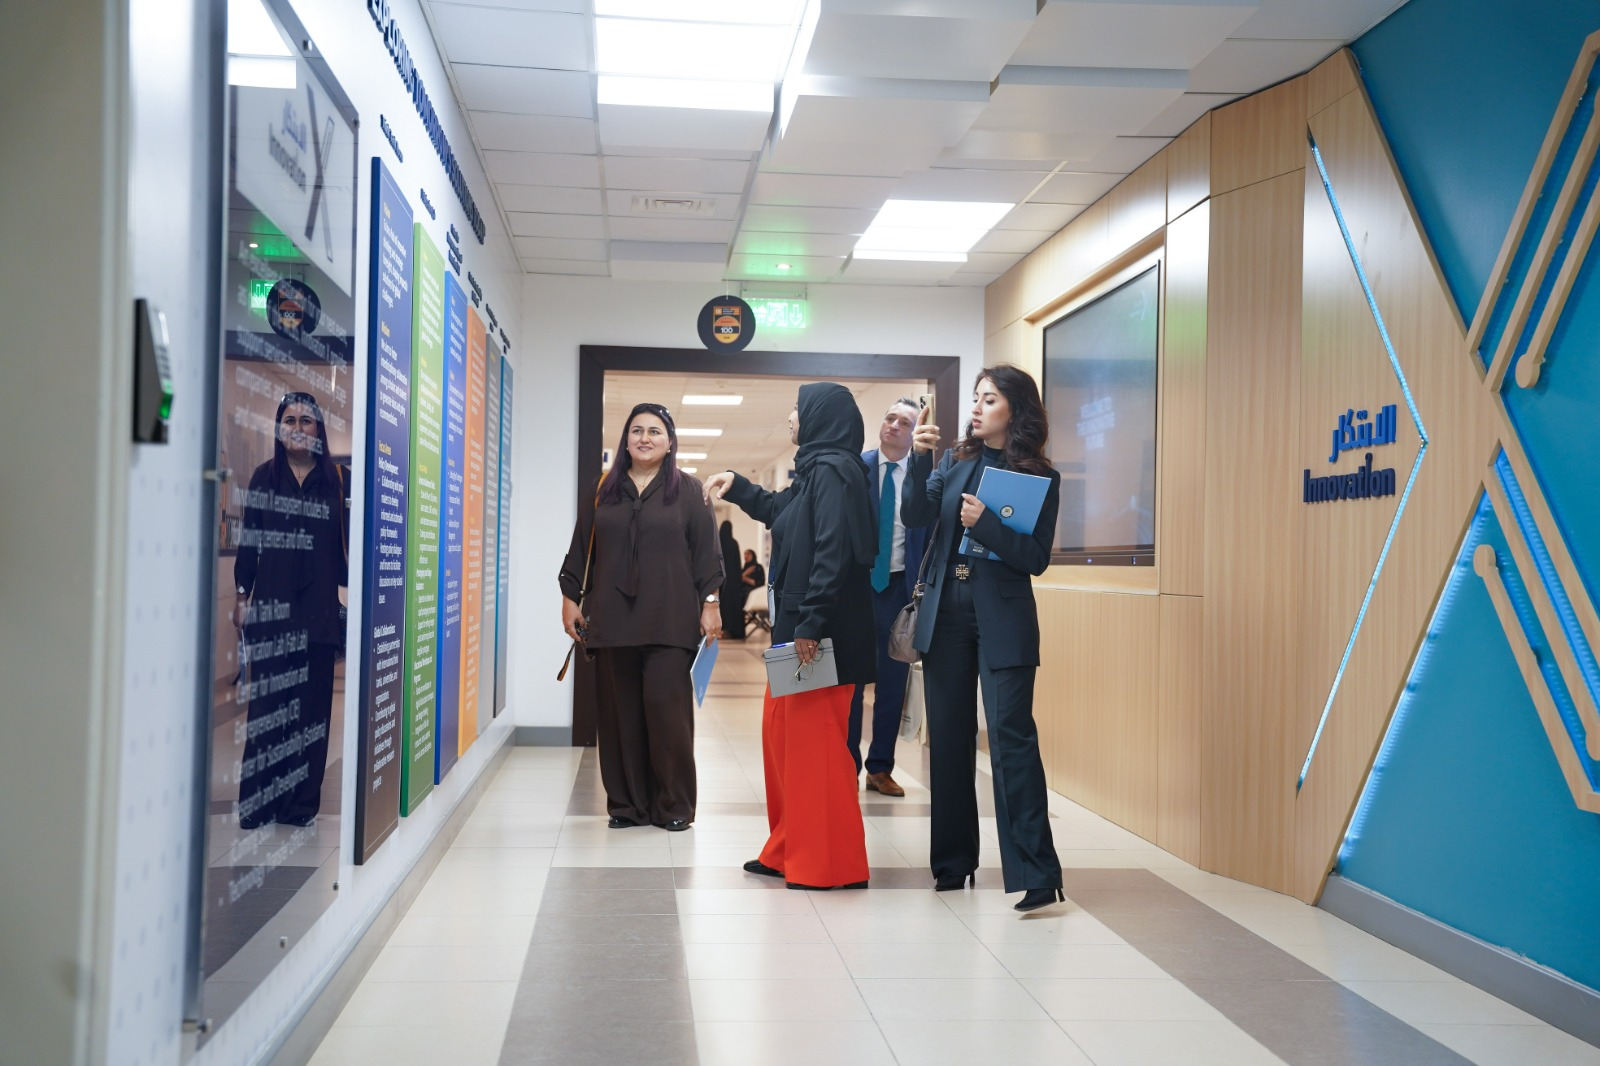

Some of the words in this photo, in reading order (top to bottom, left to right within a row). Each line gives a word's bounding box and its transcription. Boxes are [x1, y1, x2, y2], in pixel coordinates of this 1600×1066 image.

[269, 122, 306, 194] Innovation
[1304, 452, 1396, 503] Innovation
[233, 482, 267, 509] Innovation
[269, 490, 275, 510] X
[275, 495, 302, 521] ecosystem
[304, 497, 321, 518] includes
[265, 526, 285, 547] centers
[286, 529, 296, 548] and
[239, 600, 257, 625] Think
[259, 600, 273, 622] Tank
[274, 599, 290, 620] Room
[274, 633, 284, 656] Lab
[285, 631, 296, 657] (Fab
[297, 629, 308, 653] Lab)
[236, 678, 258, 705] Center
[260, 673, 269, 697] for
[270, 666, 298, 693] Innovation
[299, 661, 308, 683] and
[235, 702, 287, 744] Entrepreneurship
[234, 754, 256, 786] Center
[257, 748, 266, 772] for
[267, 730, 302, 767] Sustainability
[232, 785, 261, 826] Research
[263, 778, 274, 806] and
[276, 757, 309, 797] Development
